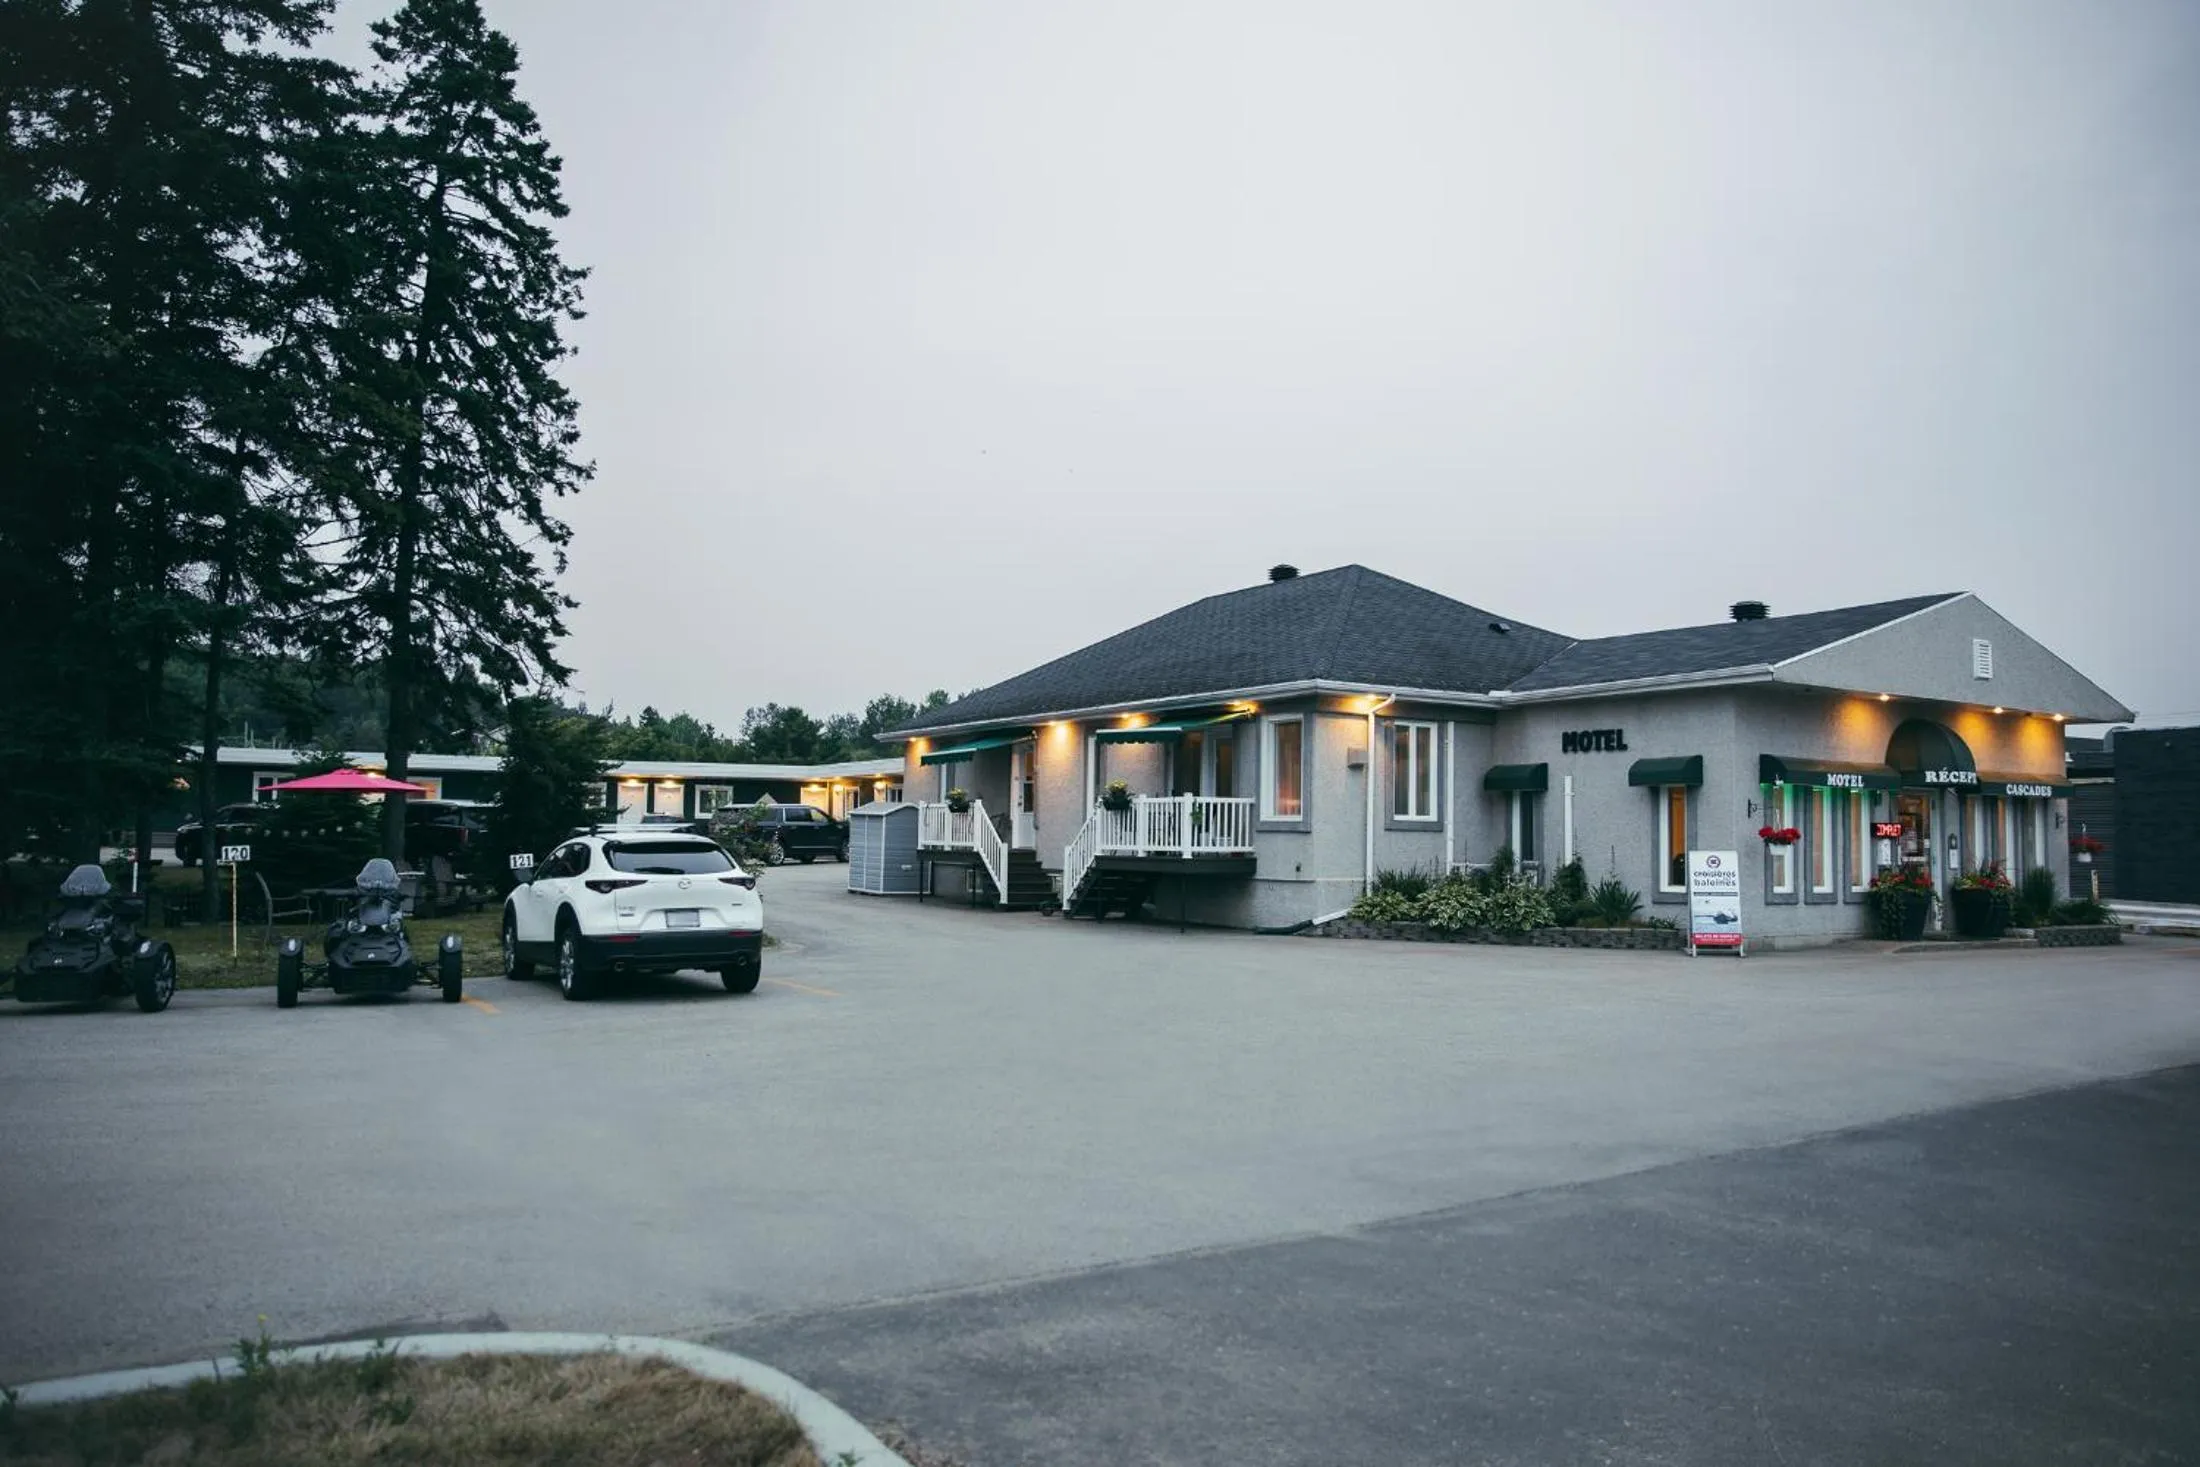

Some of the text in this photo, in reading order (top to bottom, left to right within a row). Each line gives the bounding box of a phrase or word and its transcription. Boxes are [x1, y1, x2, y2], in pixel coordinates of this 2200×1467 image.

[1562, 729, 1628, 754] MOTEL
[1827, 773, 1864, 787] MOTEL
[2006, 784, 2052, 797] CASCADES
[224, 847, 248, 860] 120
[512, 854, 531, 868] 121
